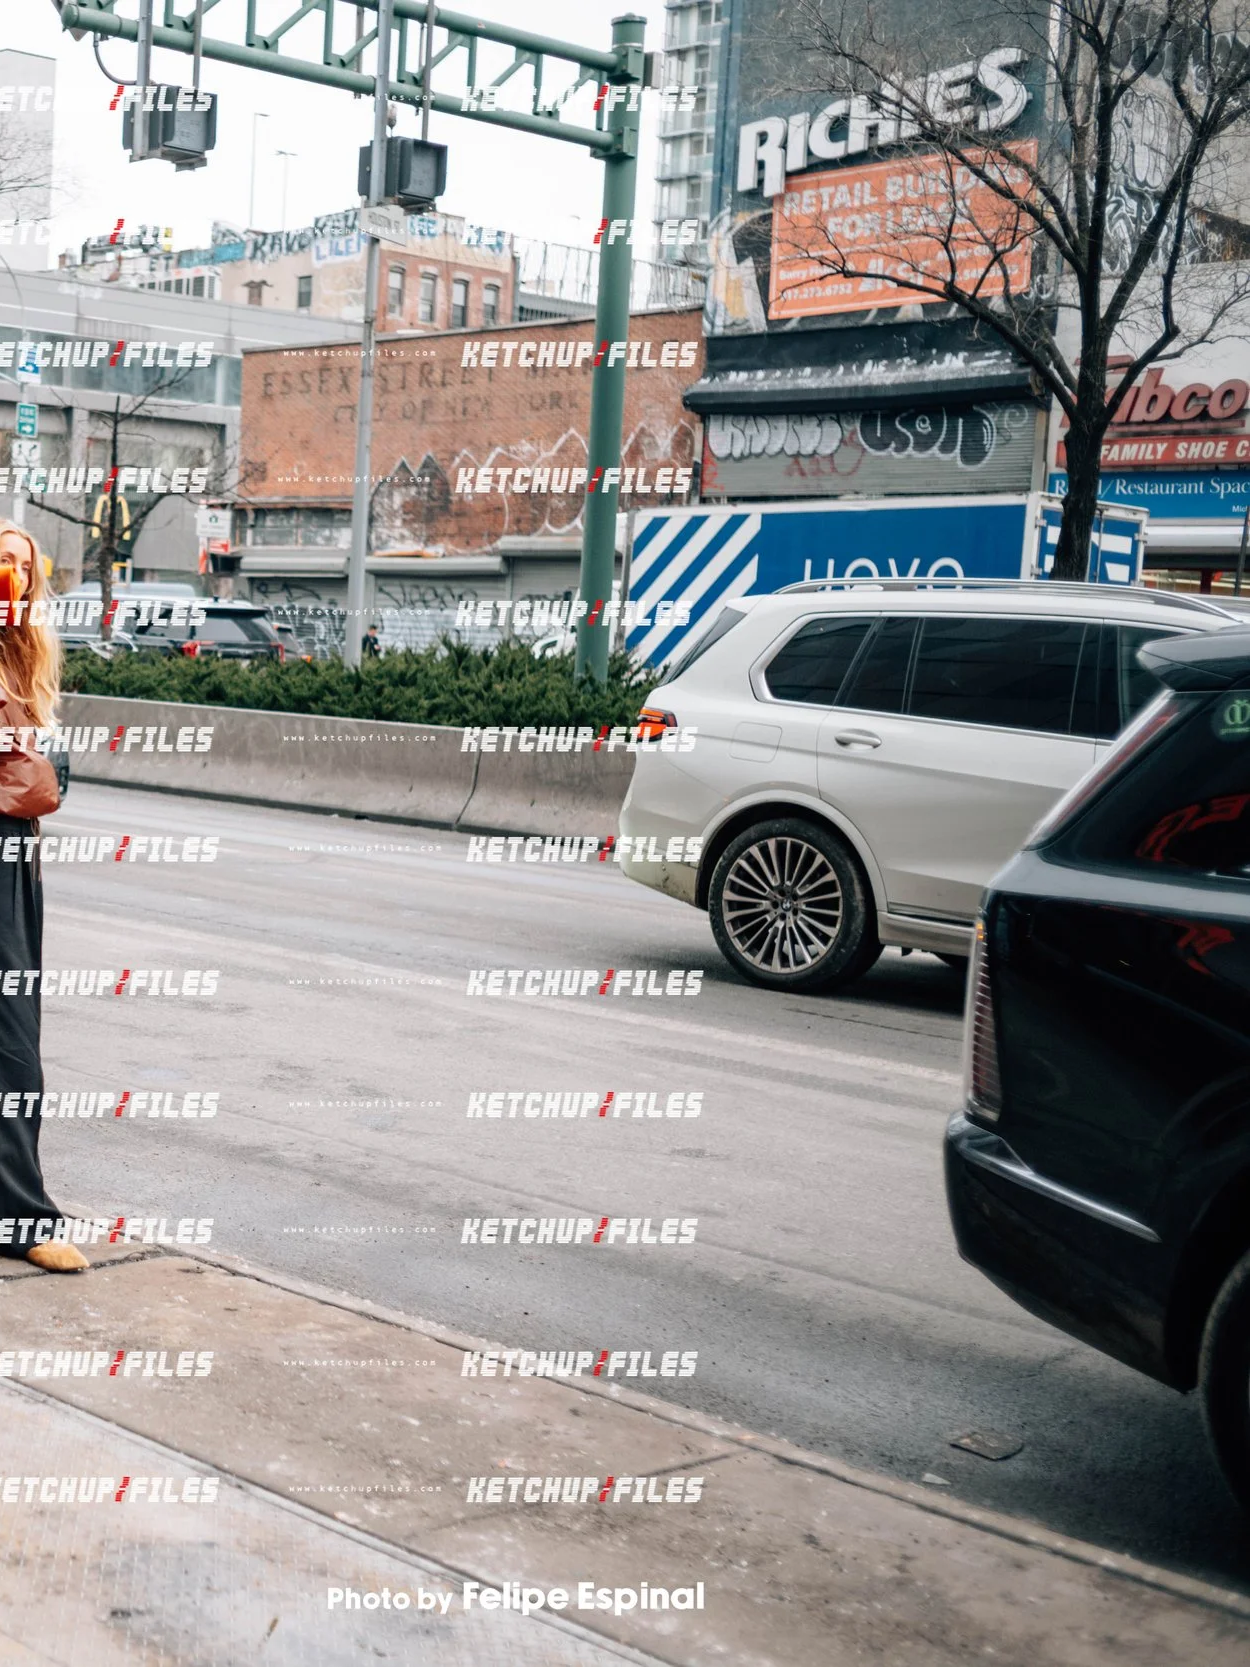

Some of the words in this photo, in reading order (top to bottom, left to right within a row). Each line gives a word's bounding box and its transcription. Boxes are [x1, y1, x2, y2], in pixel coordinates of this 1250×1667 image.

[783, 181, 879, 217] RETAIL
[827, 210, 881, 240] FOR
[1100, 442, 1168, 461] FAMILY
[1175, 440, 1228, 460] SHOE
